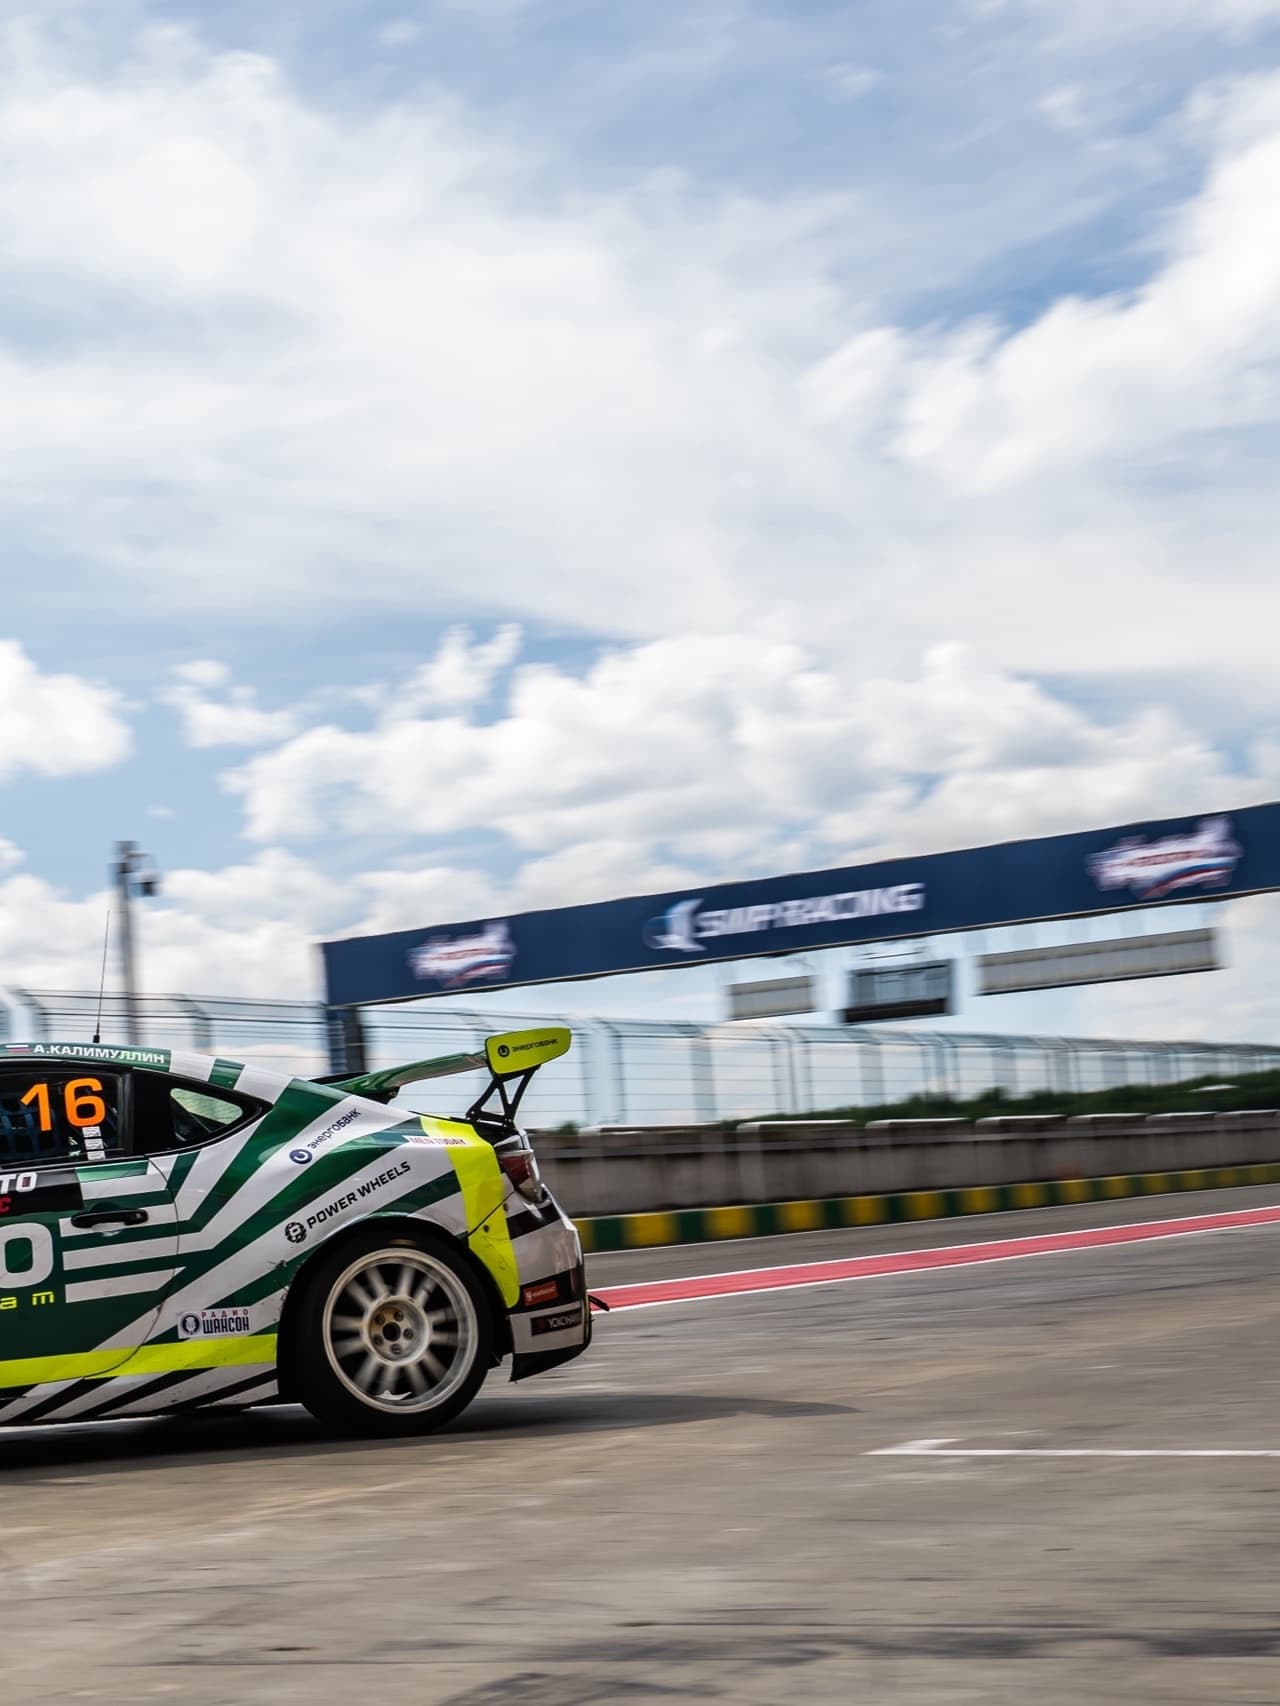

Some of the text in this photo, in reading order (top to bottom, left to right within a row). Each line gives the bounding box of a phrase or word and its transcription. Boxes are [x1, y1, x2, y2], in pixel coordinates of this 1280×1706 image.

[33, 1044, 165, 1064] А.КАЛИМУЛЛИН
[20, 1077, 106, 1132] 16
[306, 1160, 412, 1229] POWER WHEELS
[202, 1308, 249, 1319] РАДИО
[202, 1316, 251, 1334] ШАНСОН
